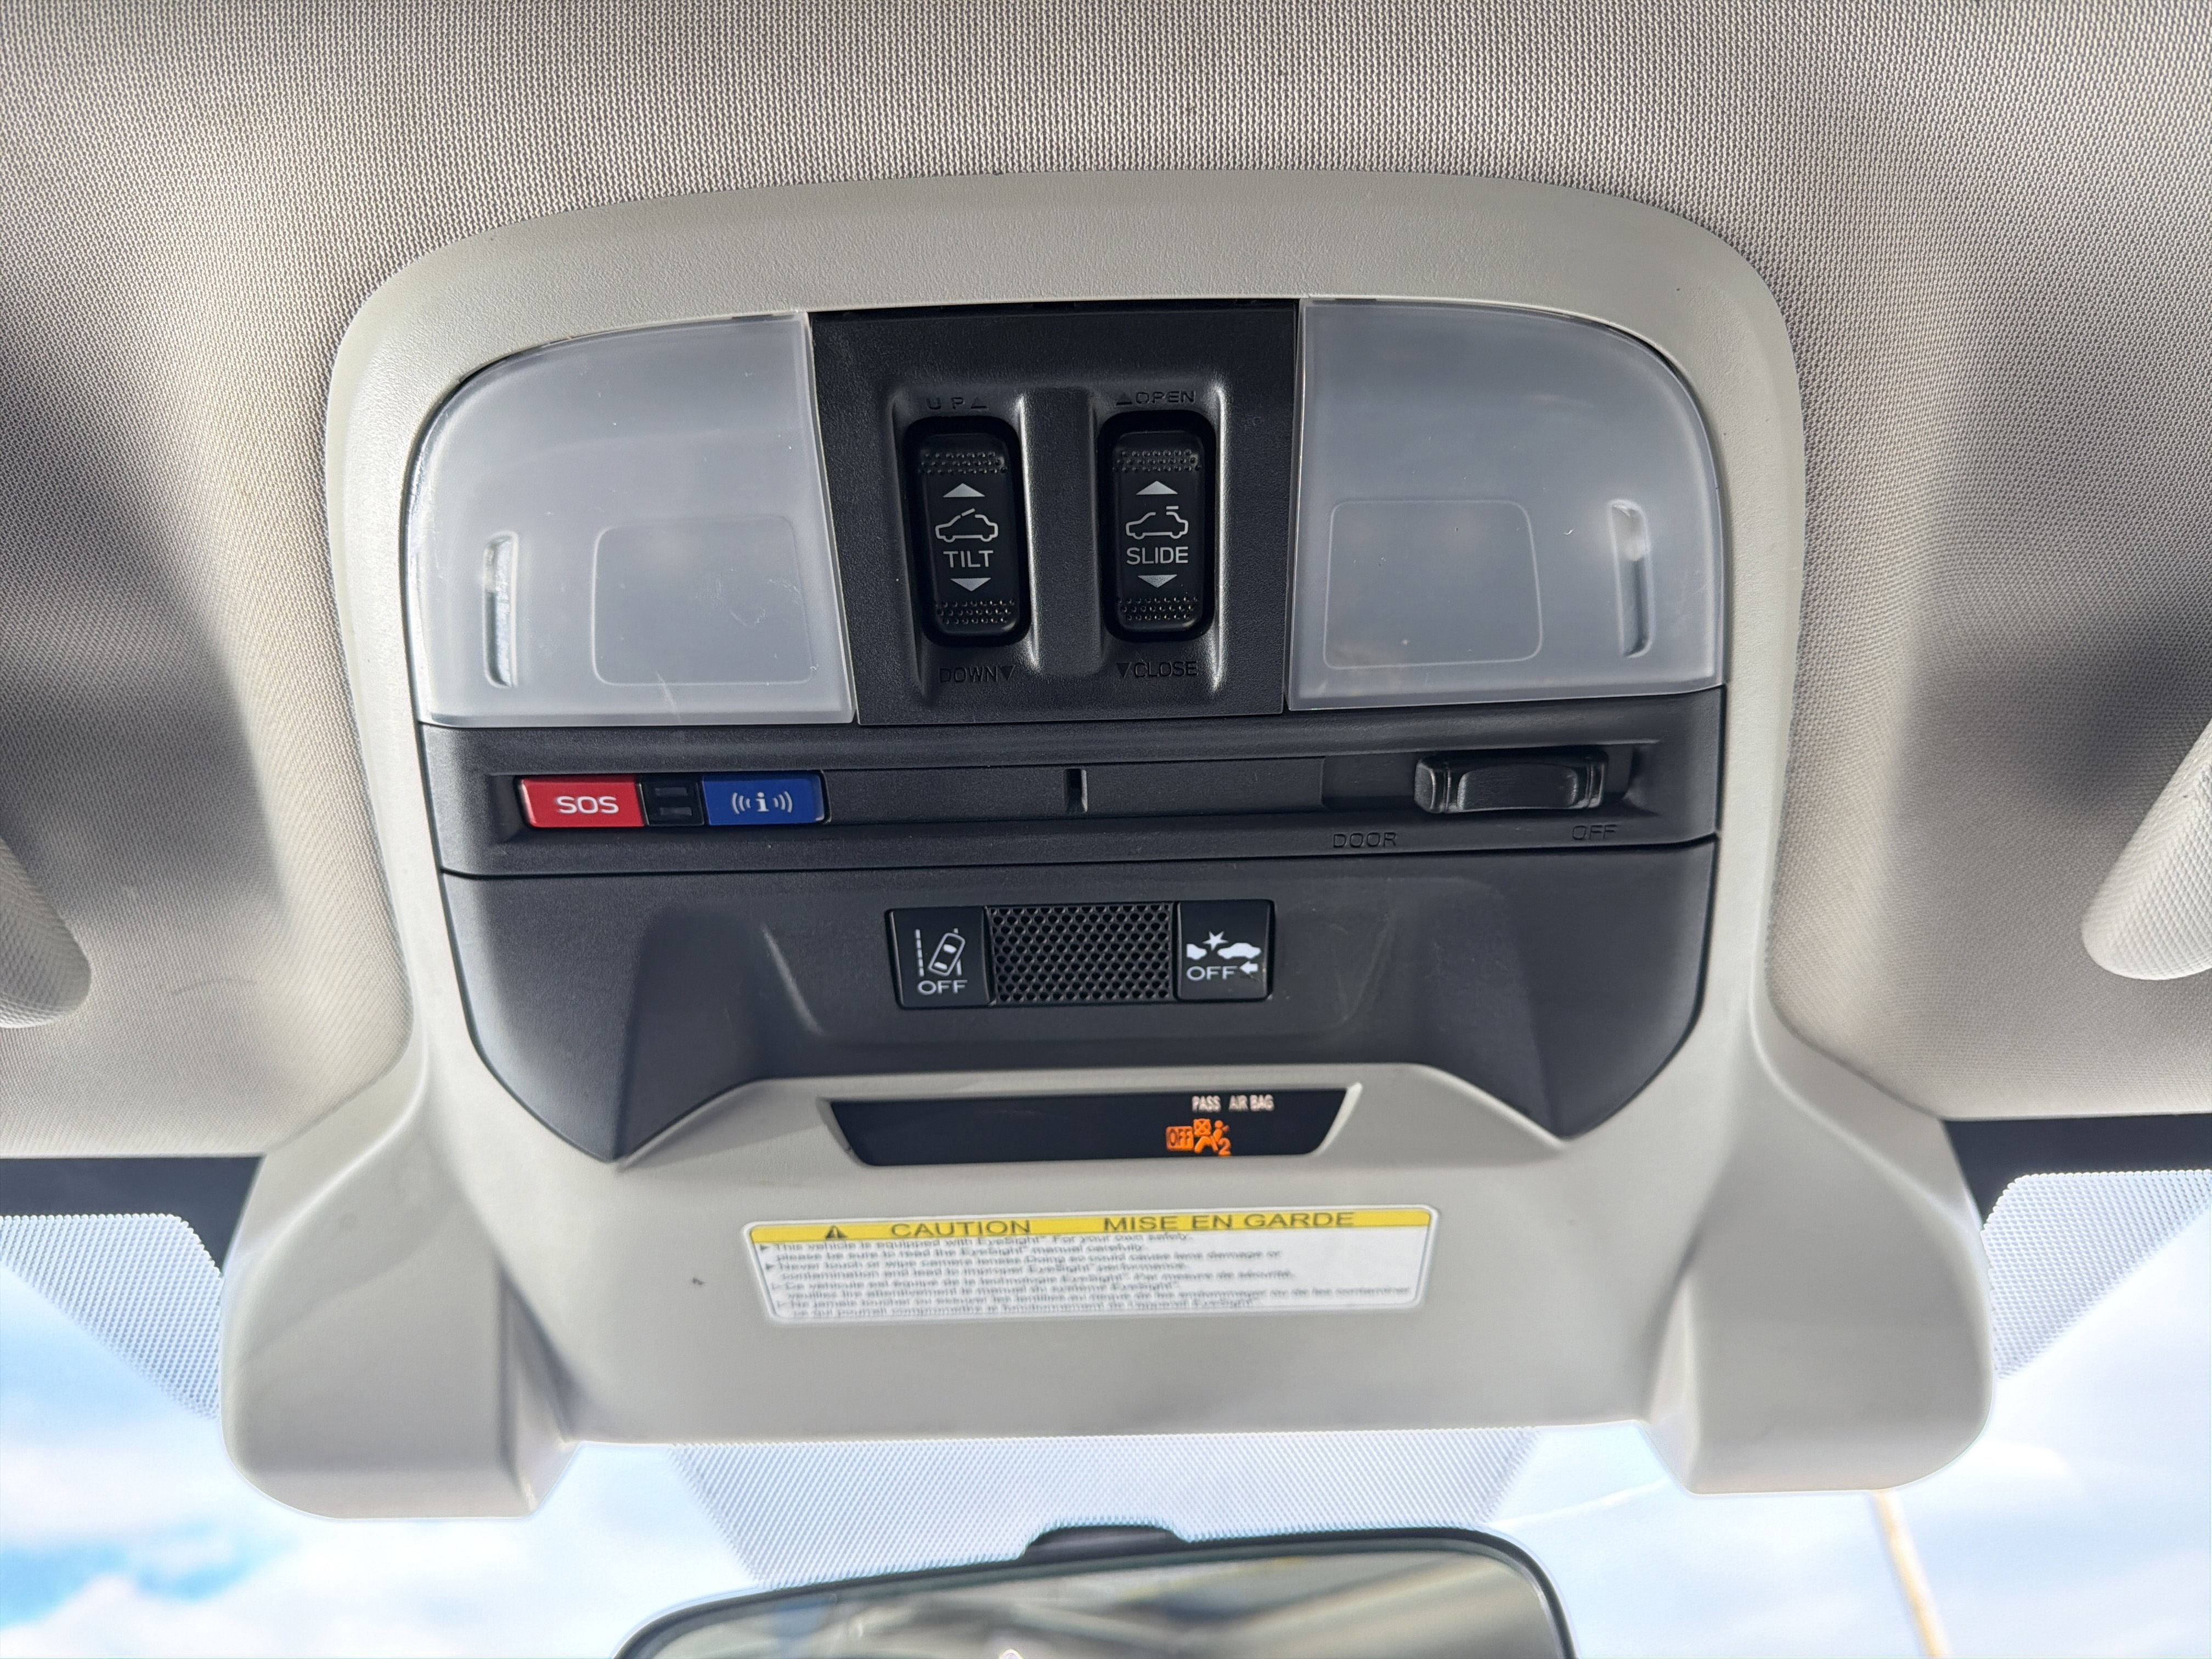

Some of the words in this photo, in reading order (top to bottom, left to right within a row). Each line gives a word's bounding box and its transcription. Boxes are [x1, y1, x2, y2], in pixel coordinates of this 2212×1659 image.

[1136, 390, 1195, 404] OPEN
[943, 550, 994, 568] TILT
[1126, 546, 1189, 565] SLIDE
[939, 666, 998, 684] DOWN
[1133, 661, 1198, 678] CLOSE
[556, 795, 619, 814] SOS
[1333, 832, 1397, 849] DOOR
[1572, 824, 1618, 841] OFF
[1186, 966, 1238, 981] OFF
[917, 979, 968, 996] OFF
[1191, 1095, 1222, 1113] PASS
[1228, 1094, 1249, 1111] AIR
[1249, 1094, 1274, 1111] BAG
[1168, 1127, 1193, 1147] OFF
[1217, 1137, 1232, 1156] 2
[891, 1220, 1031, 1237] CAUTION
[1104, 1216, 1177, 1232] MISE
[1191, 1214, 1233, 1230] EN
[1244, 1211, 1355, 1229] GARDE
[775, 1242, 803, 1250] This
[807, 1241, 856, 1250] vehicle
[876, 1239, 940, 1249] equipped
[944, 1238, 973, 1246] with
[1079, 1235, 1110, 1244] your
[776, 1252, 822, 1262] please
[899, 1249, 930, 1257] read
[935, 1248, 956, 1256] the
[1031, 1245, 1083, 1254] manual
[778, 1262, 820, 1270] Never
[823, 1261, 862, 1269] touch
[884, 1259, 917, 1268] wipe
[1087, 1254, 1126, 1262] could
[1173, 1251, 1204, 1260] lens
[1206, 1250, 1263, 1260] damage
[882, 1269, 909, 1277] and
